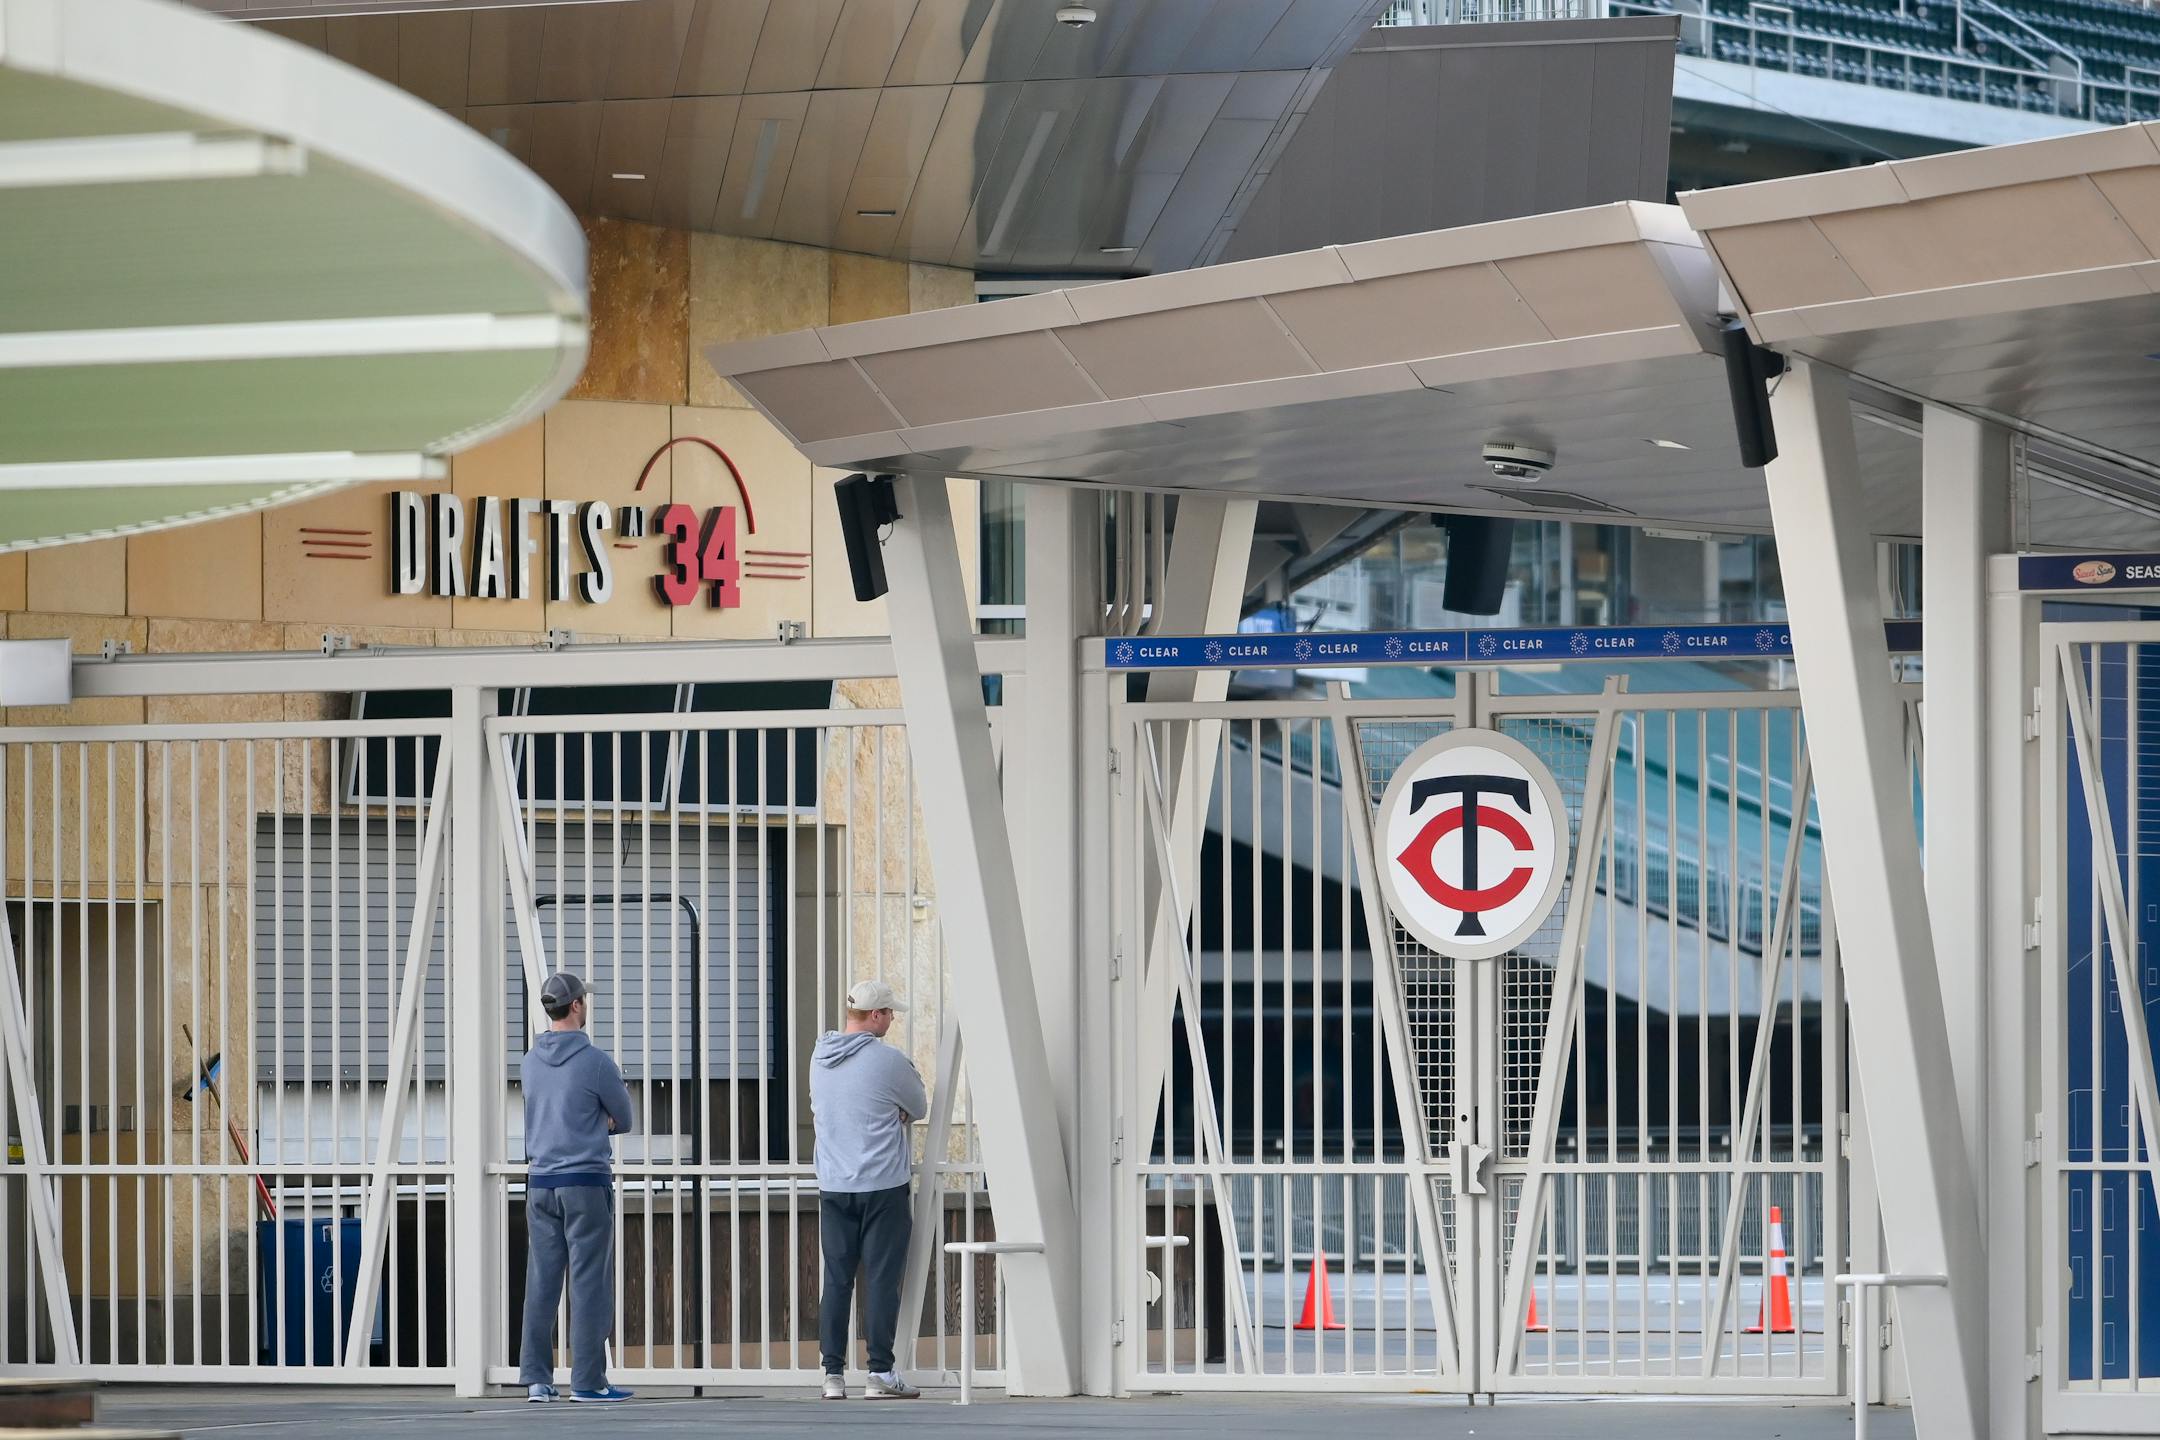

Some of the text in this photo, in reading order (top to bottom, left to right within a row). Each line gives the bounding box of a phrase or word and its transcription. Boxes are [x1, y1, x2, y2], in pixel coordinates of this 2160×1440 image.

[389, 491, 613, 603] DRAFTS
[652, 504, 741, 608] 34
[1409, 641, 1449, 652] CLEAR
[1503, 639, 1543, 650] CLEAR
[1594, 637, 1635, 648] CLEAR
[1687, 636, 1728, 646] CLEAR
[1139, 647, 1179, 658] CLEAR
[1228, 645, 1268, 656] CLEAR
[1318, 643, 1358, 654] CLEAR
